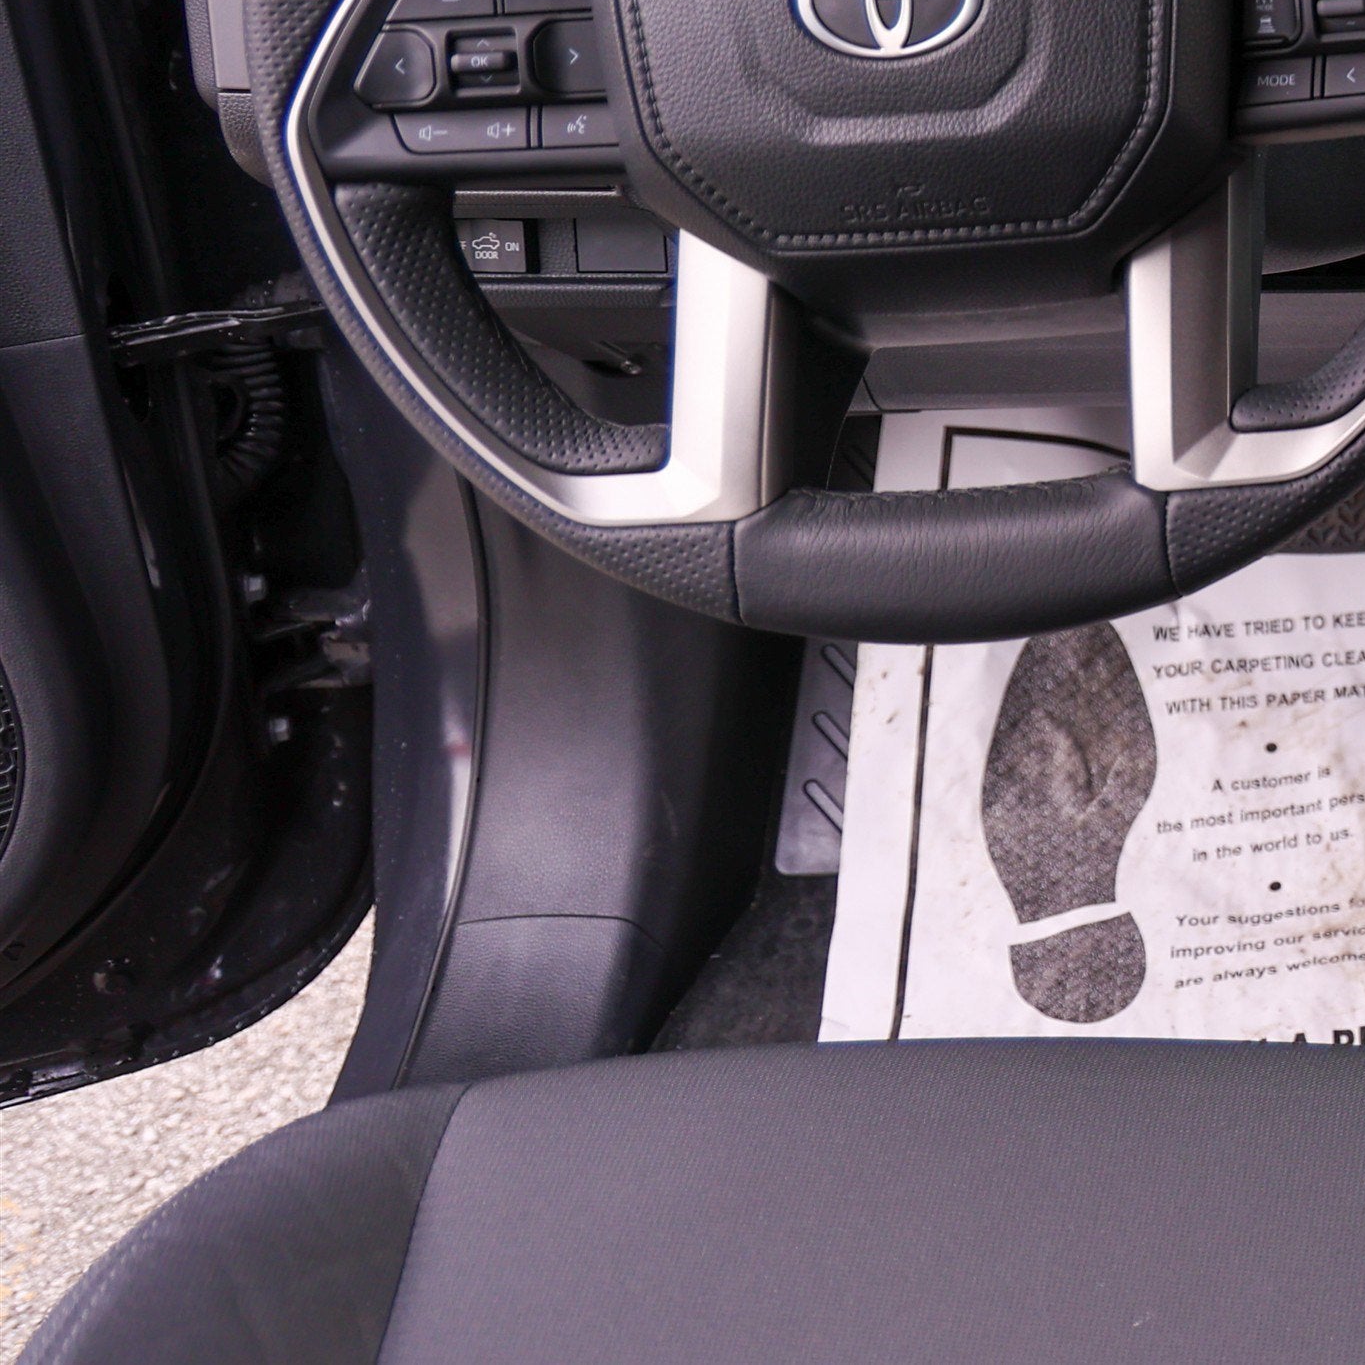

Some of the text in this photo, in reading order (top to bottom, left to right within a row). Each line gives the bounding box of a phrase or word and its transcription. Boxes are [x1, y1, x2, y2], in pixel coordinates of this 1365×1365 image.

[470, 56, 487, 67] OK
[1257, 74, 1295, 86] MODE
[475, 250, 499, 260] DOOR
[505, 242, 520, 252] ON
[1153, 626, 1180, 642] WE
[1188, 623, 1234, 639] HAVE
[1244, 618, 1294, 635] TRIED
[1304, 616, 1325, 630] TO
[1152, 661, 1203, 678] YOUR
[1211, 653, 1314, 674] CARPETING
[1166, 698, 1211, 715] WITH
[1220, 695, 1257, 711] THIS
[1266, 690, 1326, 708] PAPER
[1211, 765, 1331, 792] A customer is
[1157, 821, 1184, 835] the
[1190, 811, 1234, 829] most
[1240, 799, 1322, 823] important
[1193, 828, 1354, 862] in the world to us.
[1176, 913, 1219, 927] Your
[1228, 900, 1341, 926] suggestions
[1170, 939, 1266, 960] improving
[1273, 933, 1305, 947] our
[1174, 976, 1204, 989] are
[1212, 965, 1277, 984] always
